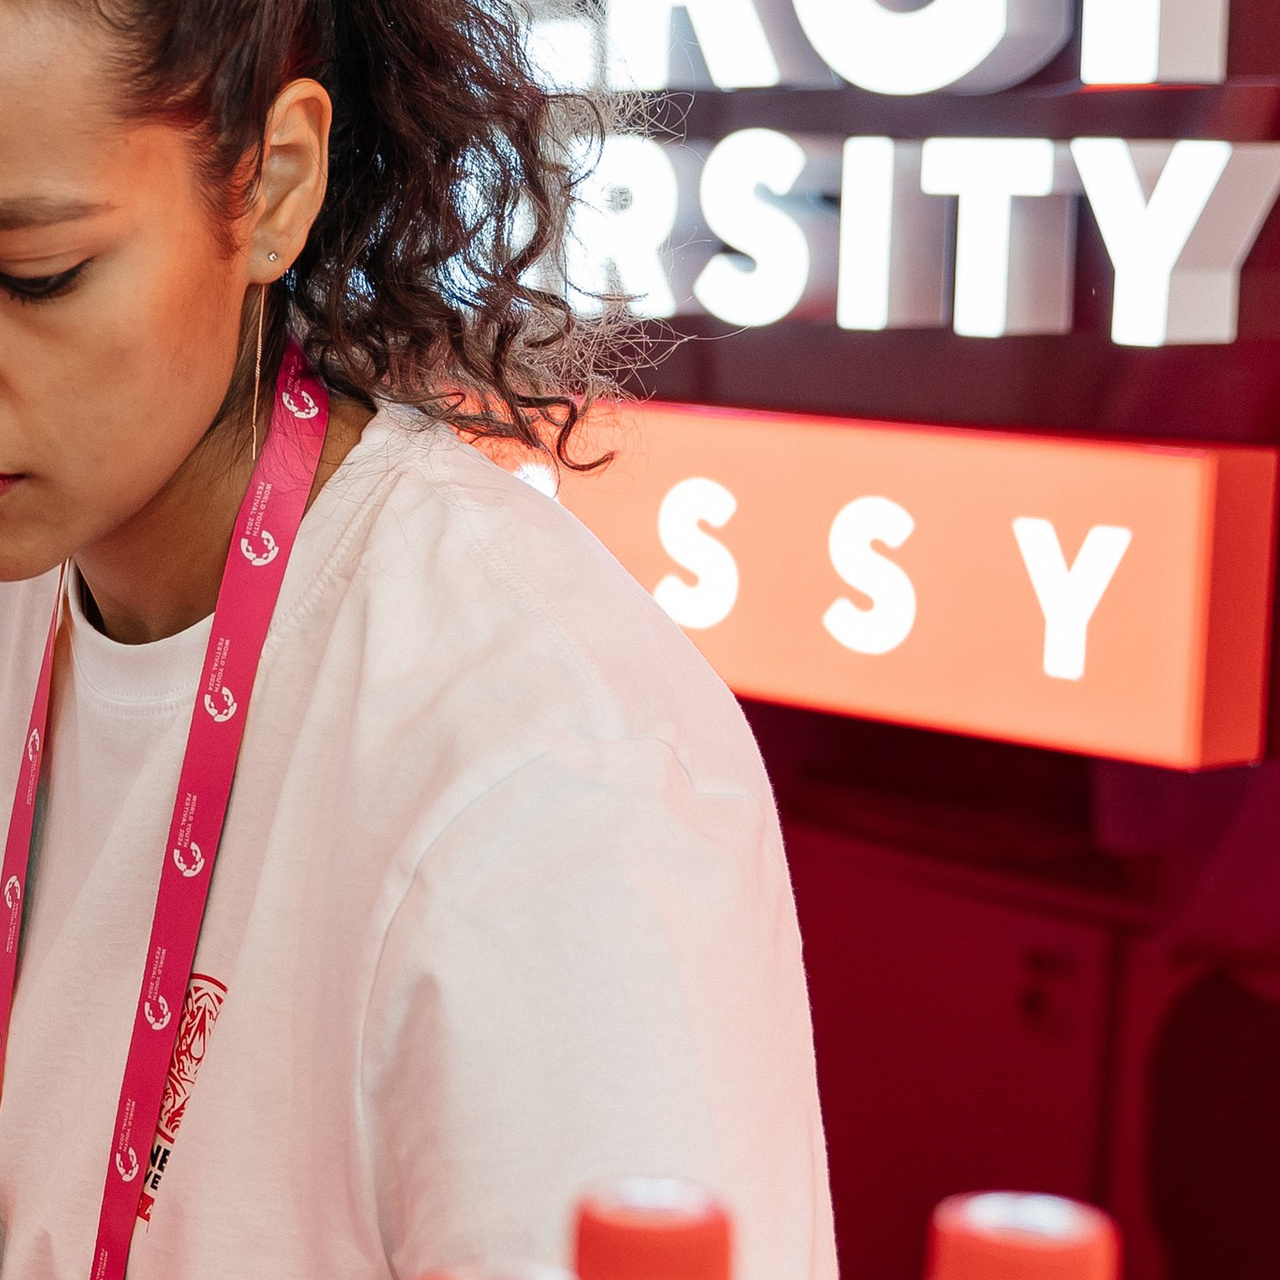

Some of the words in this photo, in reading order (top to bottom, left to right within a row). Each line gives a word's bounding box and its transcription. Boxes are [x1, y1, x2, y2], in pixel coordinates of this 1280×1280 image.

[250, 481, 265, 515] FESTIVAL
[260, 483, 272, 510] WORLD
[245, 517, 254, 534] 2024
[252, 512, 264, 536] YOUTH
[515, 464, 1133, 681] SSY
[212, 638, 224, 671] FESTIVAL
[220, 639, 230, 666] WORLD
[208, 673, 216, 691] 2024
[214, 668, 224, 692] YOUTH
